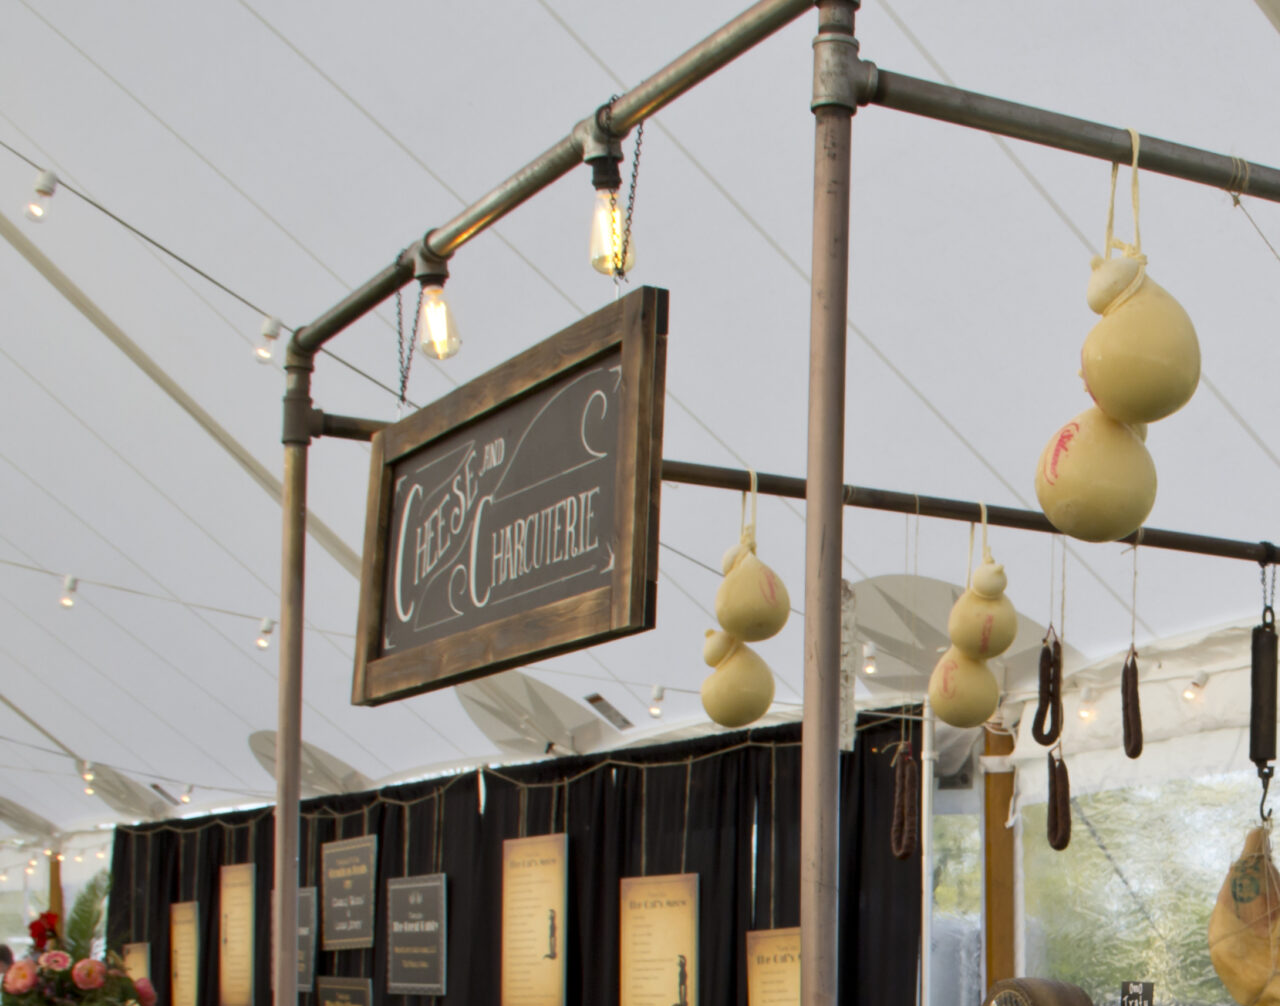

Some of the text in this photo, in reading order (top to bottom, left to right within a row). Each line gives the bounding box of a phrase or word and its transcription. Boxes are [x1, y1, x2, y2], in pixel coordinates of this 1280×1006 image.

[395, 436, 505, 623] CHEESE AND
[468, 485, 602, 609] CHARCUTERIE
